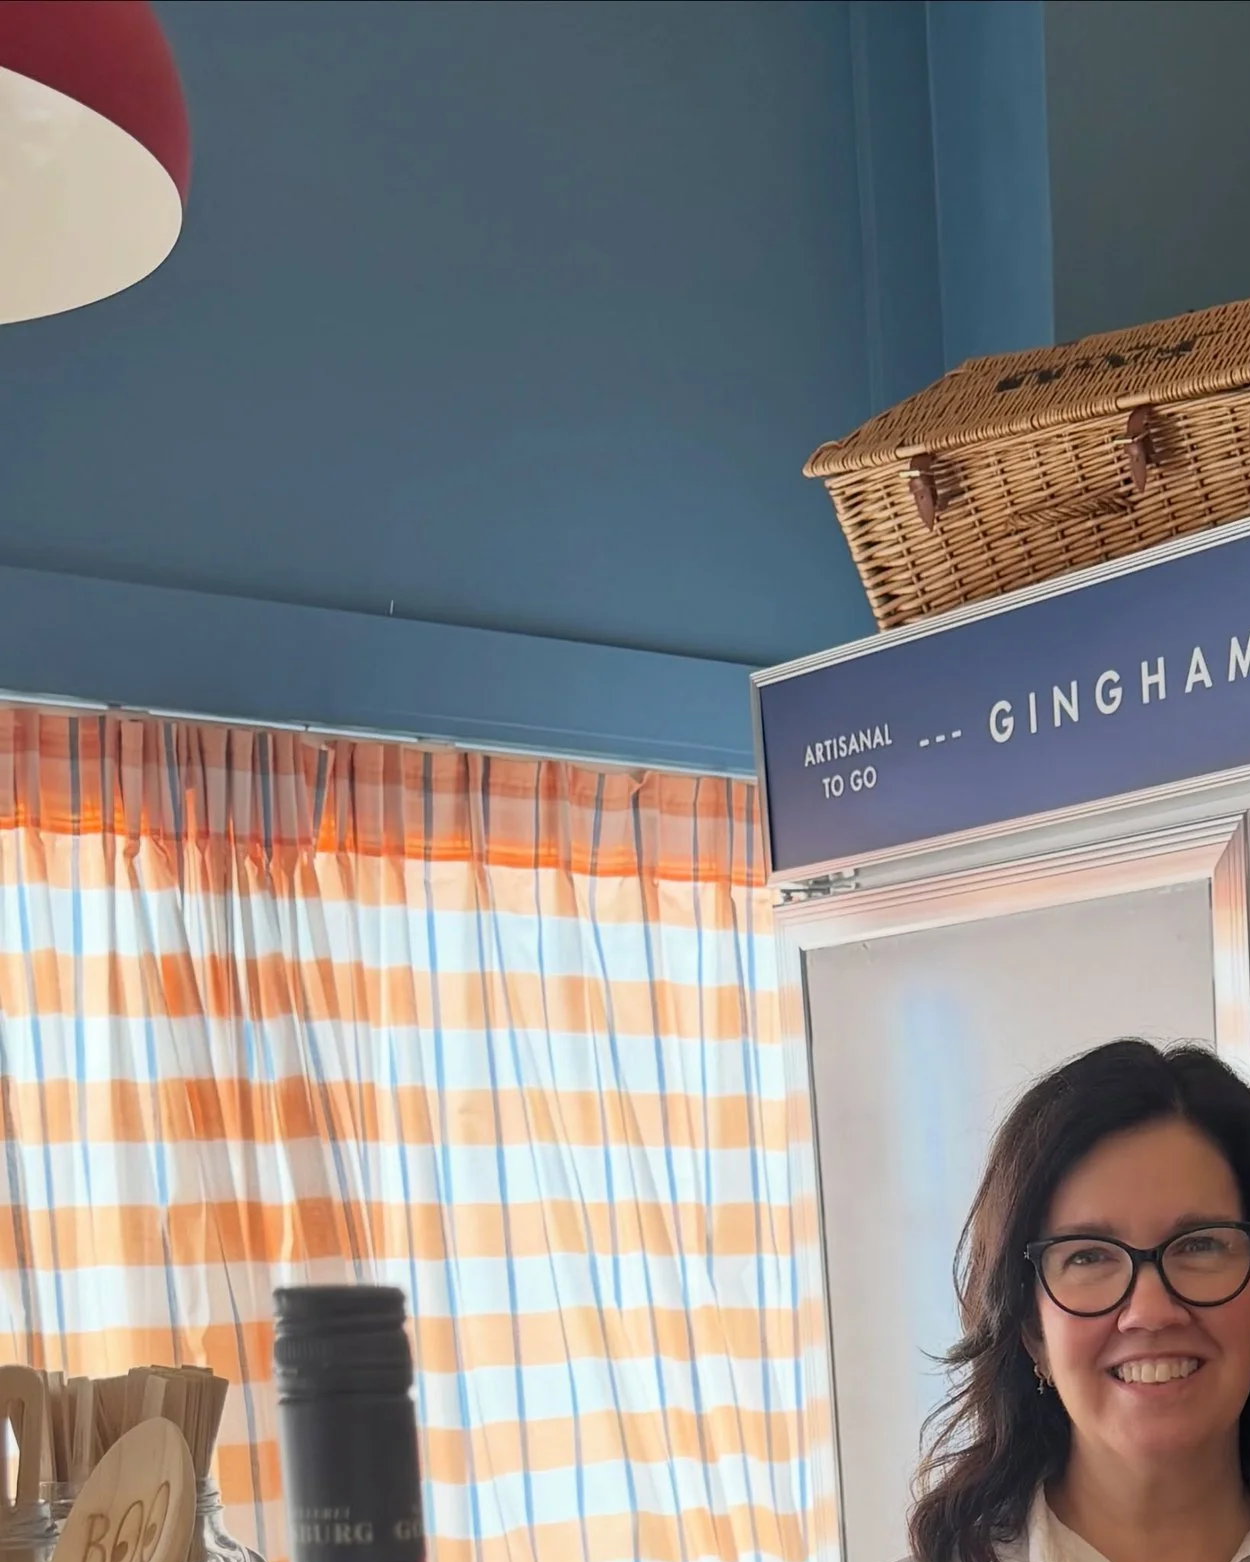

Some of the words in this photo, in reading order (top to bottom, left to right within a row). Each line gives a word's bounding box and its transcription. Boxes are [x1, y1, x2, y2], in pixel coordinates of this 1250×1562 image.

[804, 722, 893, 767] ARTISANAL
[822, 774, 844, 799] TO
[850, 766, 877, 792] GO
